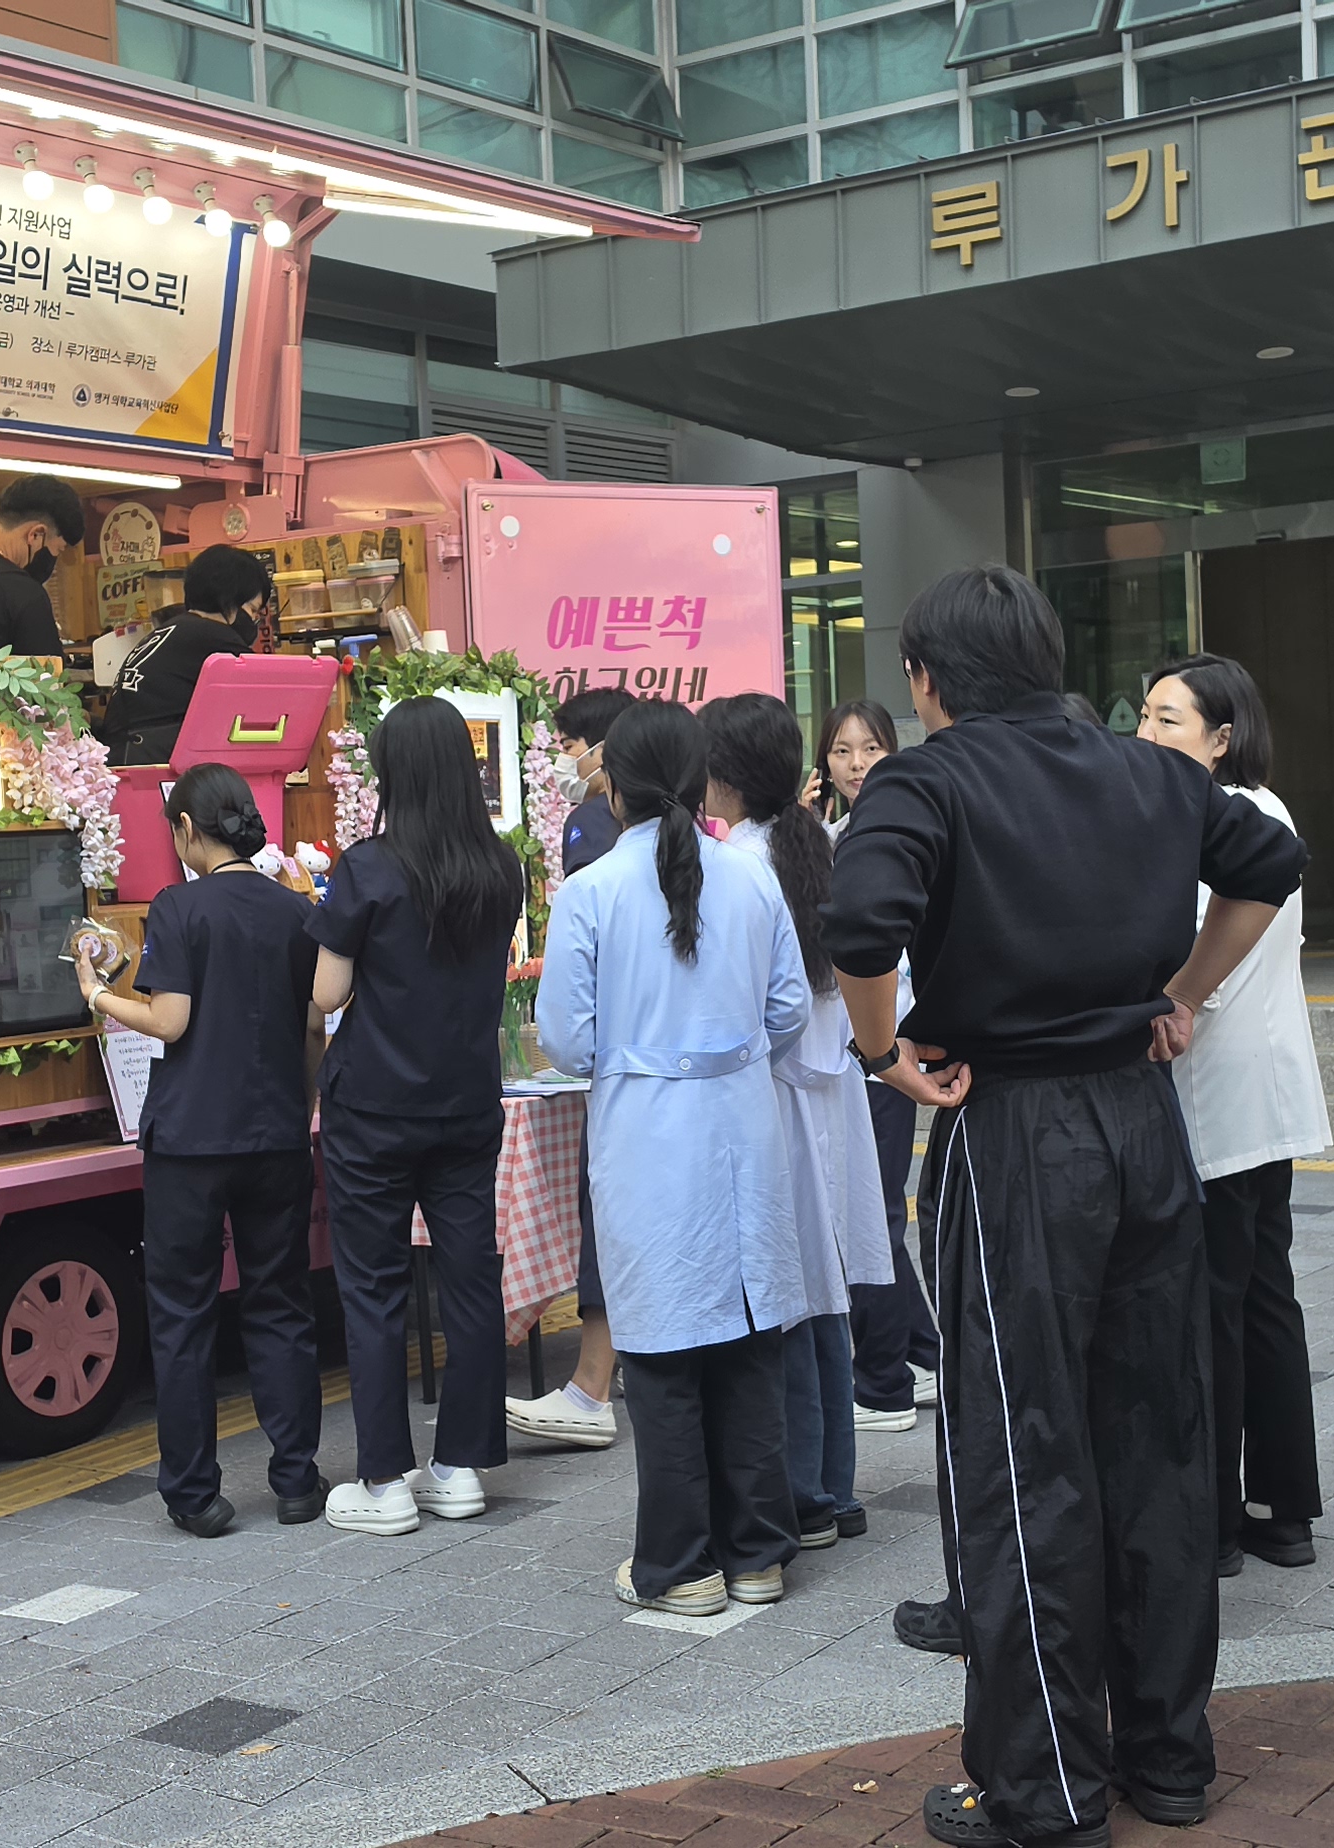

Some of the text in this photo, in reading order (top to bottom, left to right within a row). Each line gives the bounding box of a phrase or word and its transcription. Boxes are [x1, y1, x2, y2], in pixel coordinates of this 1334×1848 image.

[7, 204, 73, 240] 지원사업
[62, 252, 189, 316] 실력으로!
[33, 298, 61, 321] 개선
[31, 336, 55, 358] 장소
[65, 342, 121, 367] 루가캠퍼스
[124, 350, 157, 373] 루가관
[547, 595, 707, 652] 예쁜척
